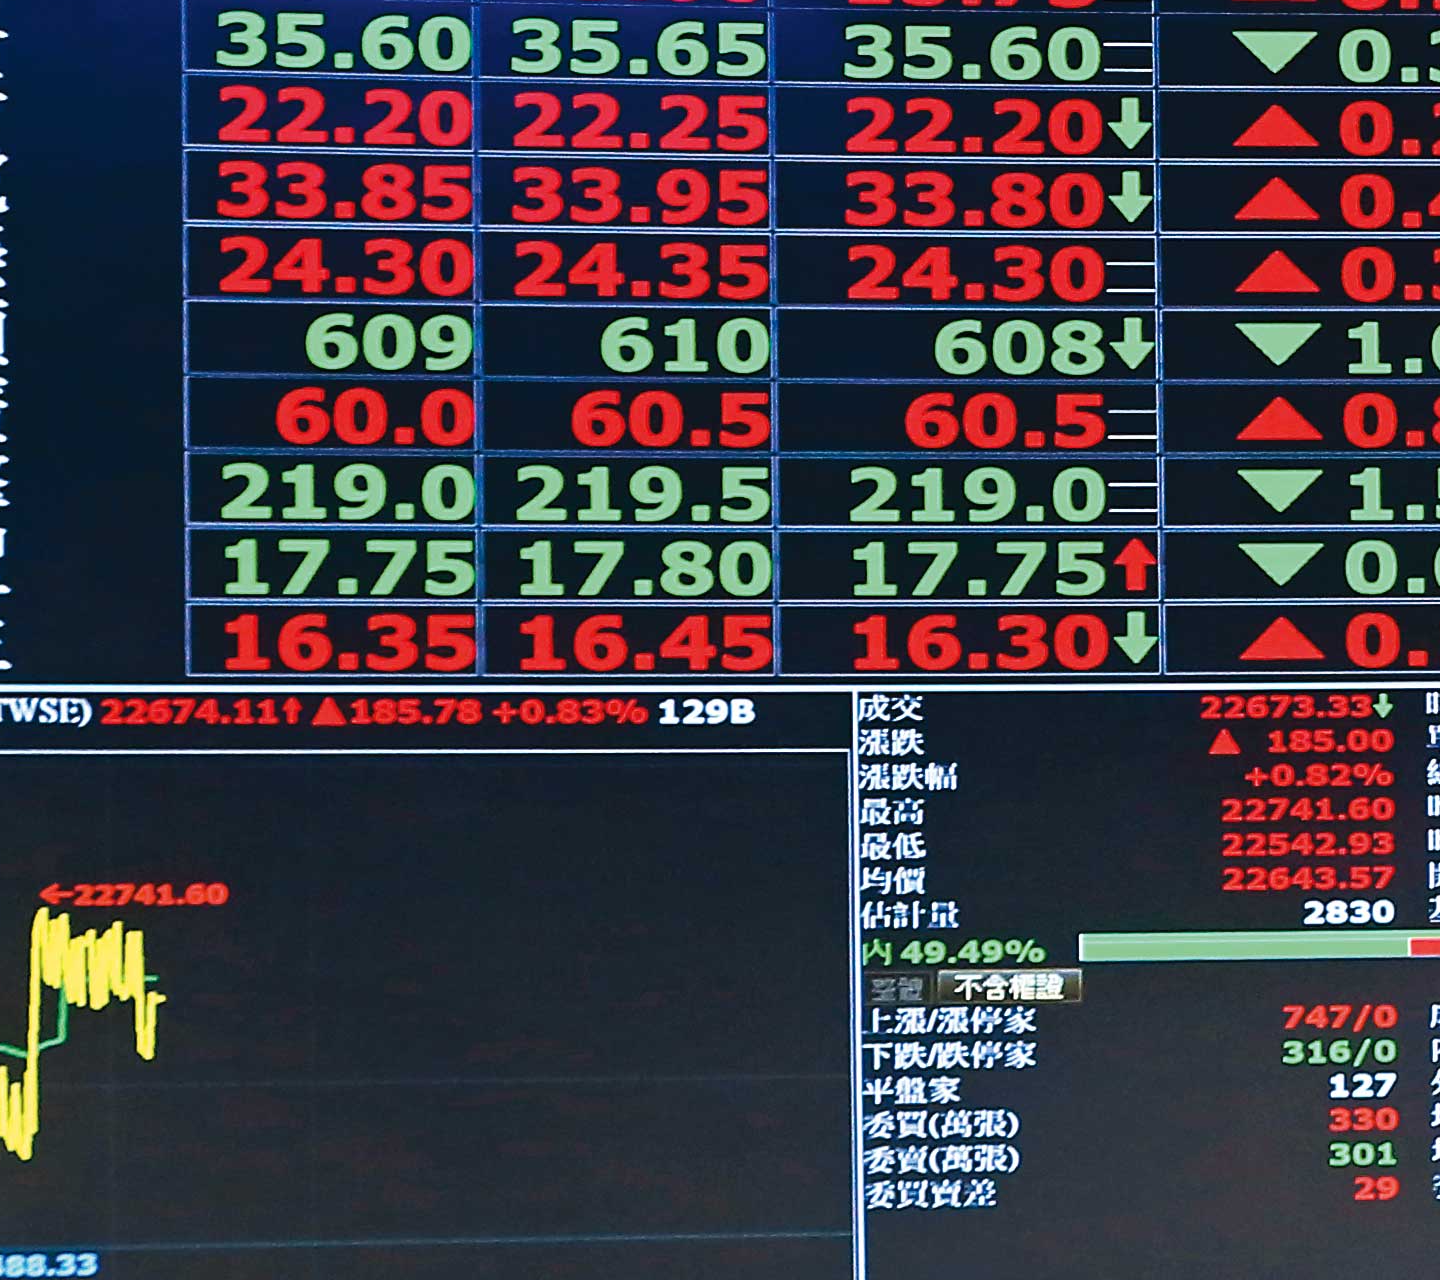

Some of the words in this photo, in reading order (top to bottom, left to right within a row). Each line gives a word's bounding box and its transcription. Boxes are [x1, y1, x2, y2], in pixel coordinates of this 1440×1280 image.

[217, 11, 472, 71] 35.60
[511, 18, 765, 76] 35.65
[844, 24, 1100, 81] 35.60
[219, 85, 473, 146] 22.20
[514, 92, 767, 150] 22.25
[846, 97, 1102, 154] 22.20
[221, 463, 477, 520] 219.0
[517, 465, 770, 521] 219.5
[850, 467, 1105, 522] 219.0
[225, 614, 477, 671] 16.35
[520, 615, 772, 671] 16.45
[854, 615, 1108, 670] 16.30
[101, 699, 279, 724] 22674.11
[351, 699, 482, 724] 185.78
[492, 699, 648, 724] +0.83%
[659, 699, 755, 724] 129B
[856, 691, 926, 724] 成交
[1201, 695, 1372, 719] 22673.33
[1268, 729, 1394, 752] 185.00
[856, 759, 957, 793] 漲跌幅
[1245, 763, 1394, 786] +0.82%
[1222, 832, 1394, 856] 22542.93
[74, 883, 228, 905] 22741.60
[1304, 900, 1394, 924] 2830
[900, 939, 1046, 964] 49.49%
[1283, 1004, 1398, 1032] 747/0
[1283, 1038, 1396, 1067] 316/0
[1330, 1073, 1396, 1098] 127
[1329, 1142, 1397, 1166] 301
